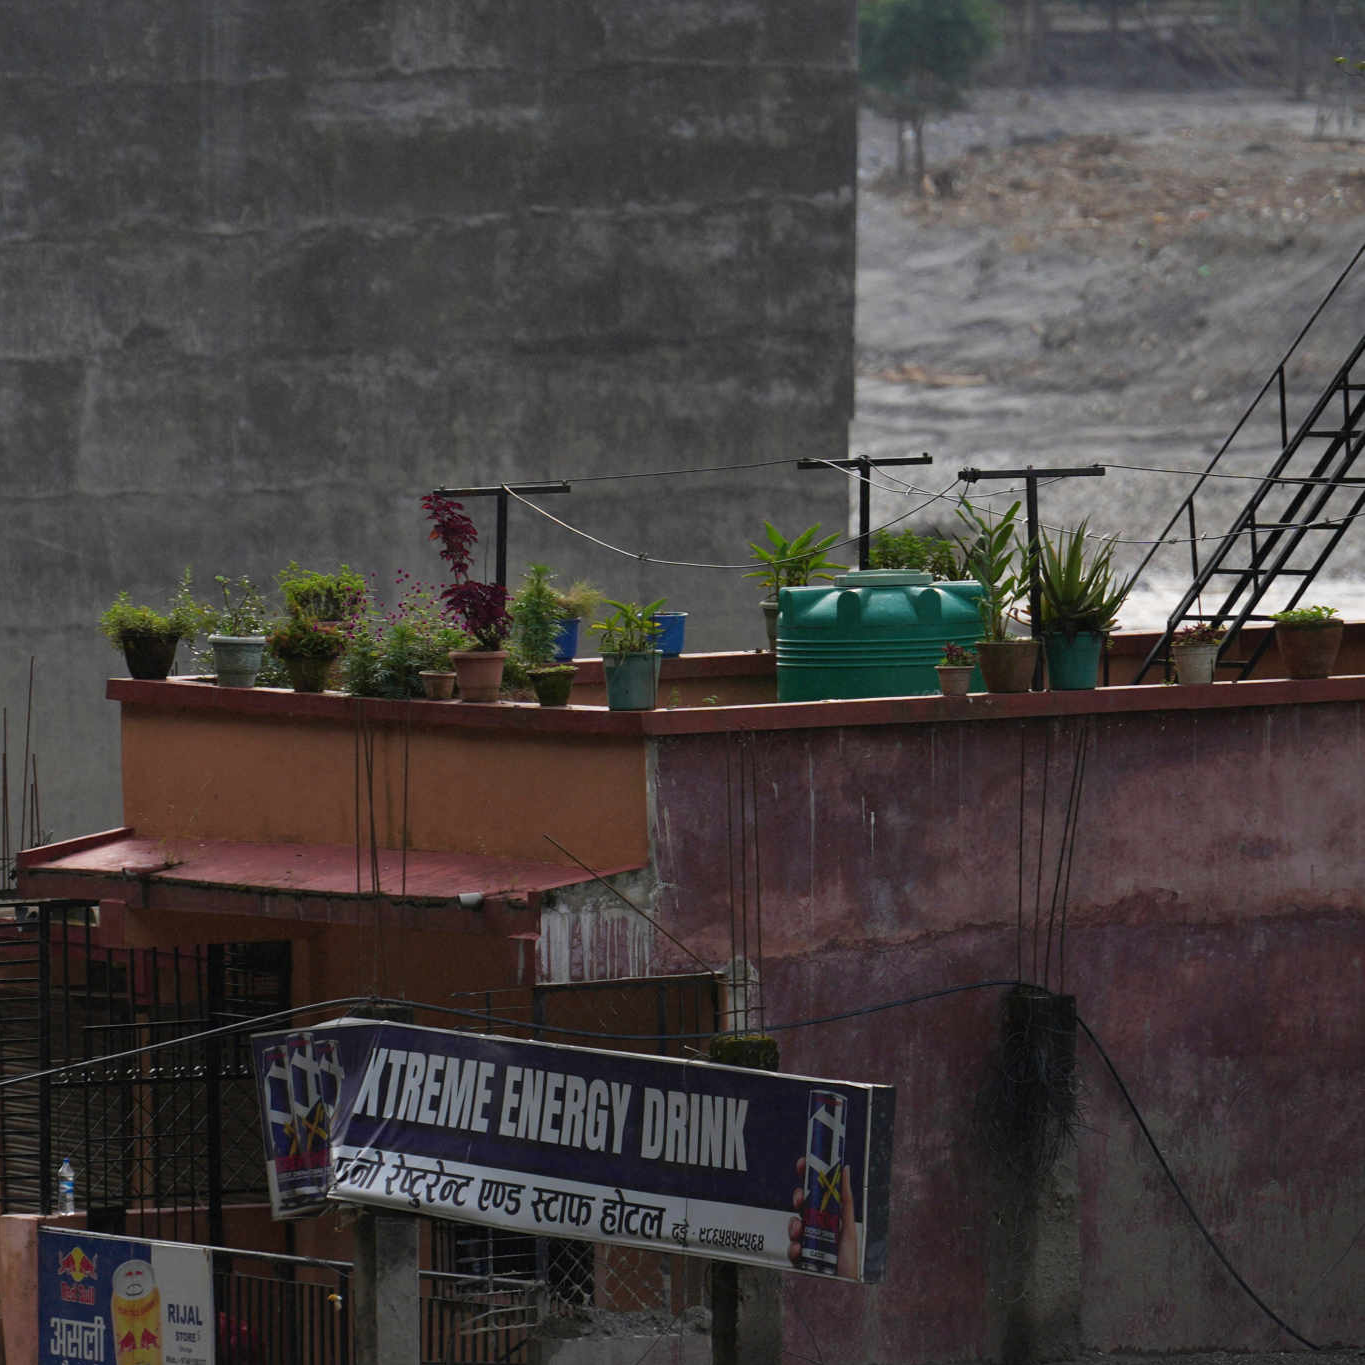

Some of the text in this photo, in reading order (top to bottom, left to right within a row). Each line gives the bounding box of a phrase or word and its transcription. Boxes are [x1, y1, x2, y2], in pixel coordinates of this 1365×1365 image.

[353, 1047, 748, 1172] XTREME ENERGY DRINK
[481, 1178, 524, 1215] एण्ड
[530, 1187, 595, 1227] स्टाफ
[600, 1188, 666, 1239] होटल
[50, 1315, 105, 1362] असली
[167, 1304, 203, 1326] RIJAL
